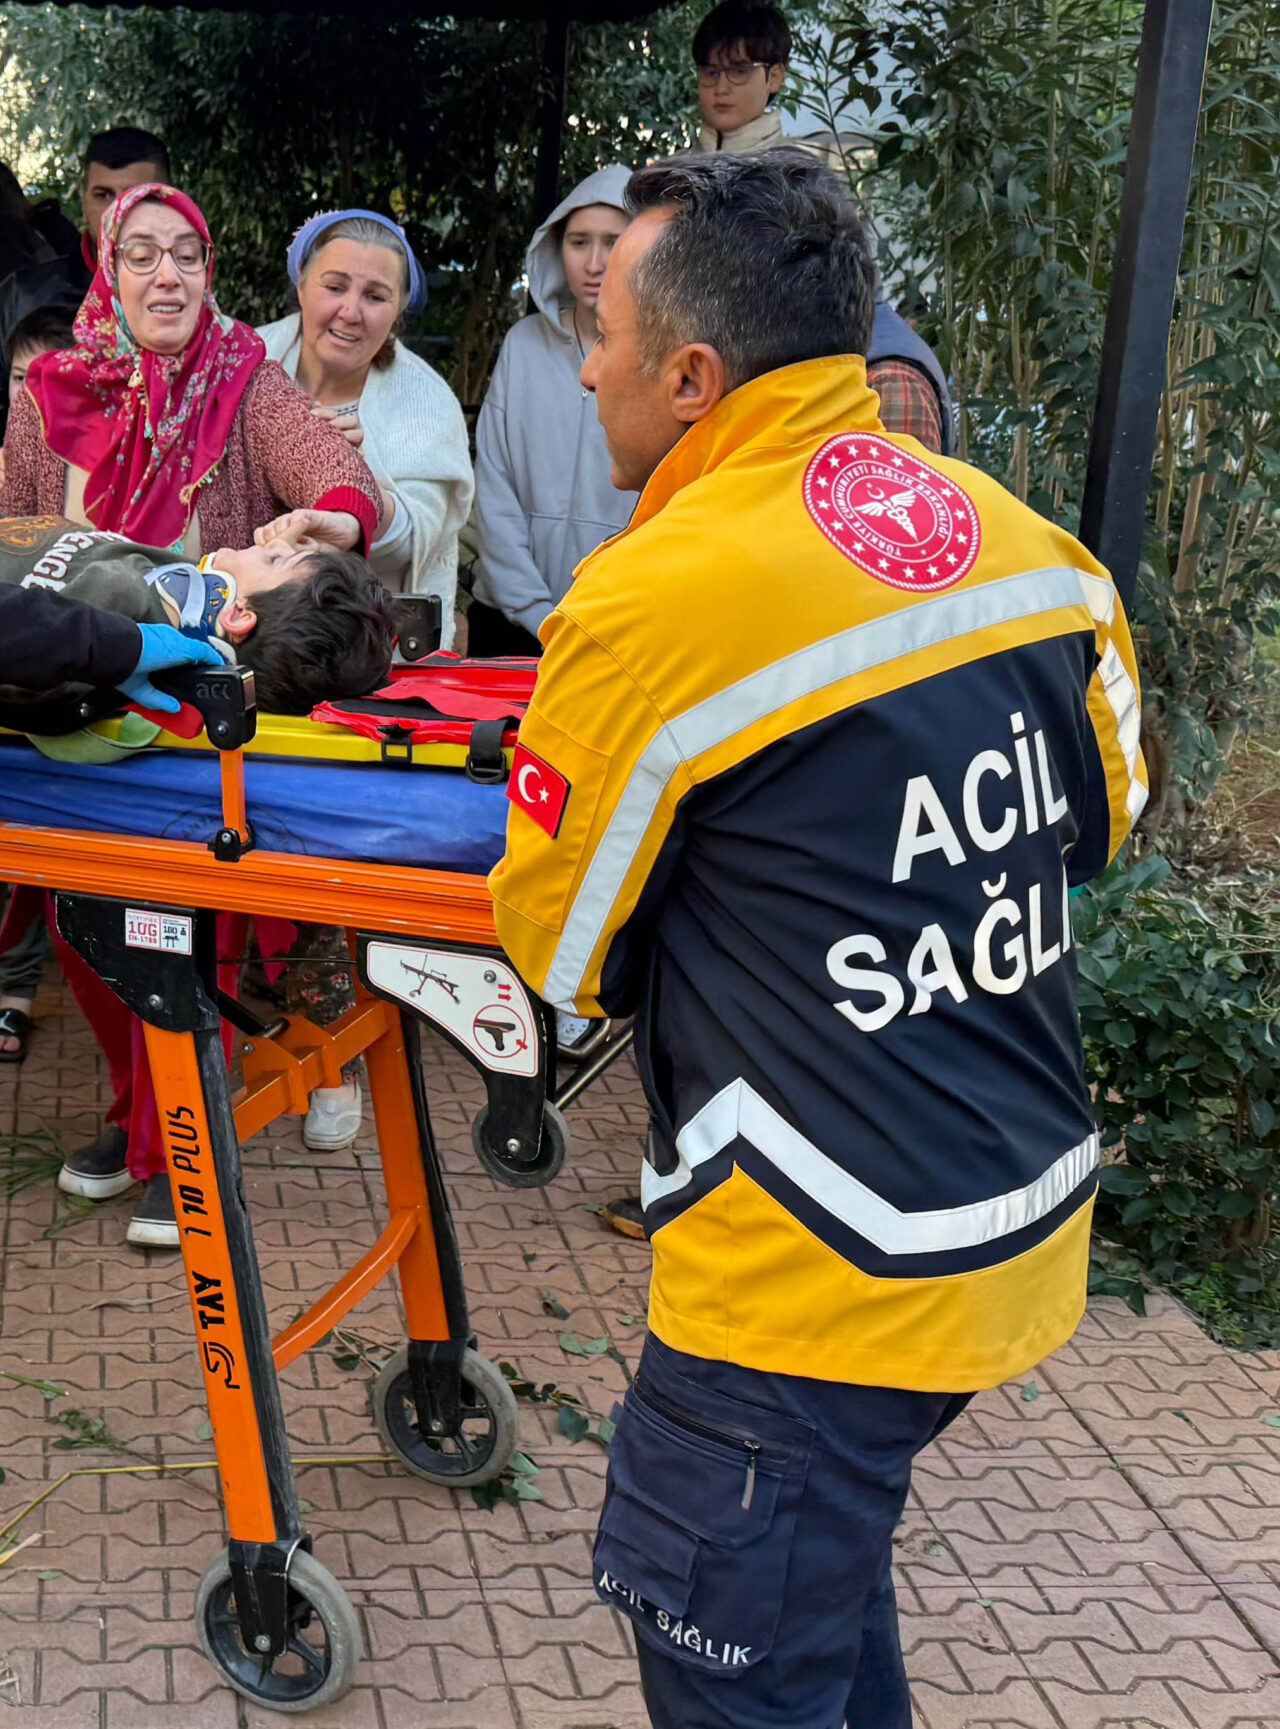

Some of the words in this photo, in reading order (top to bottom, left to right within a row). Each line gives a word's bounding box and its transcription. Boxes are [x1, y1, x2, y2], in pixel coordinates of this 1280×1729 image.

[870, 465, 915, 486] SAĞLIK
[852, 519, 902, 557] TÜRKİYE
[915, 483, 949, 540] BAKANLIĞI
[892, 711, 1069, 884] ACİL
[826, 863, 1075, 1032] SAĞLI
[166, 1105, 201, 1175] PLUS
[191, 1270, 226, 1330] TAY
[656, 1609, 752, 1666] SAĞLIK
